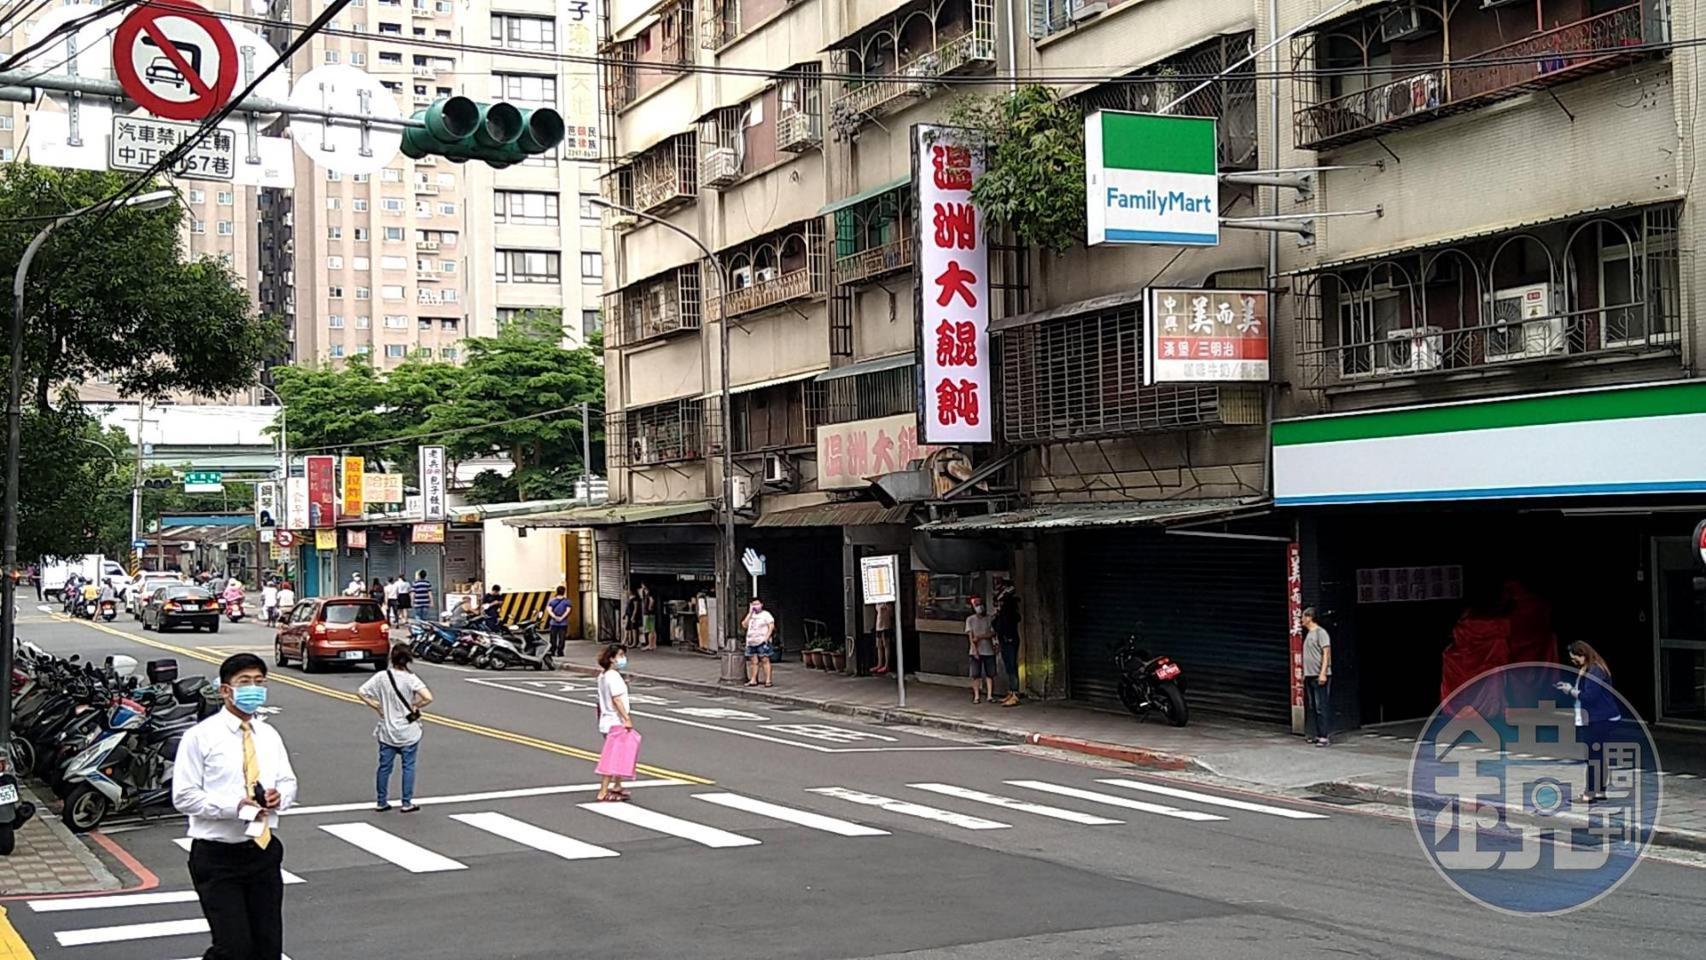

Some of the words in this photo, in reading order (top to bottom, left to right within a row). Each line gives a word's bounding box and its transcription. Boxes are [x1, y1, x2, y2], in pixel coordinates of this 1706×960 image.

[118, 122, 231, 152] 汽車禁止左轉
[1106, 187, 1212, 216] FamilyMart
[1188, 295, 1262, 335] 美而美
